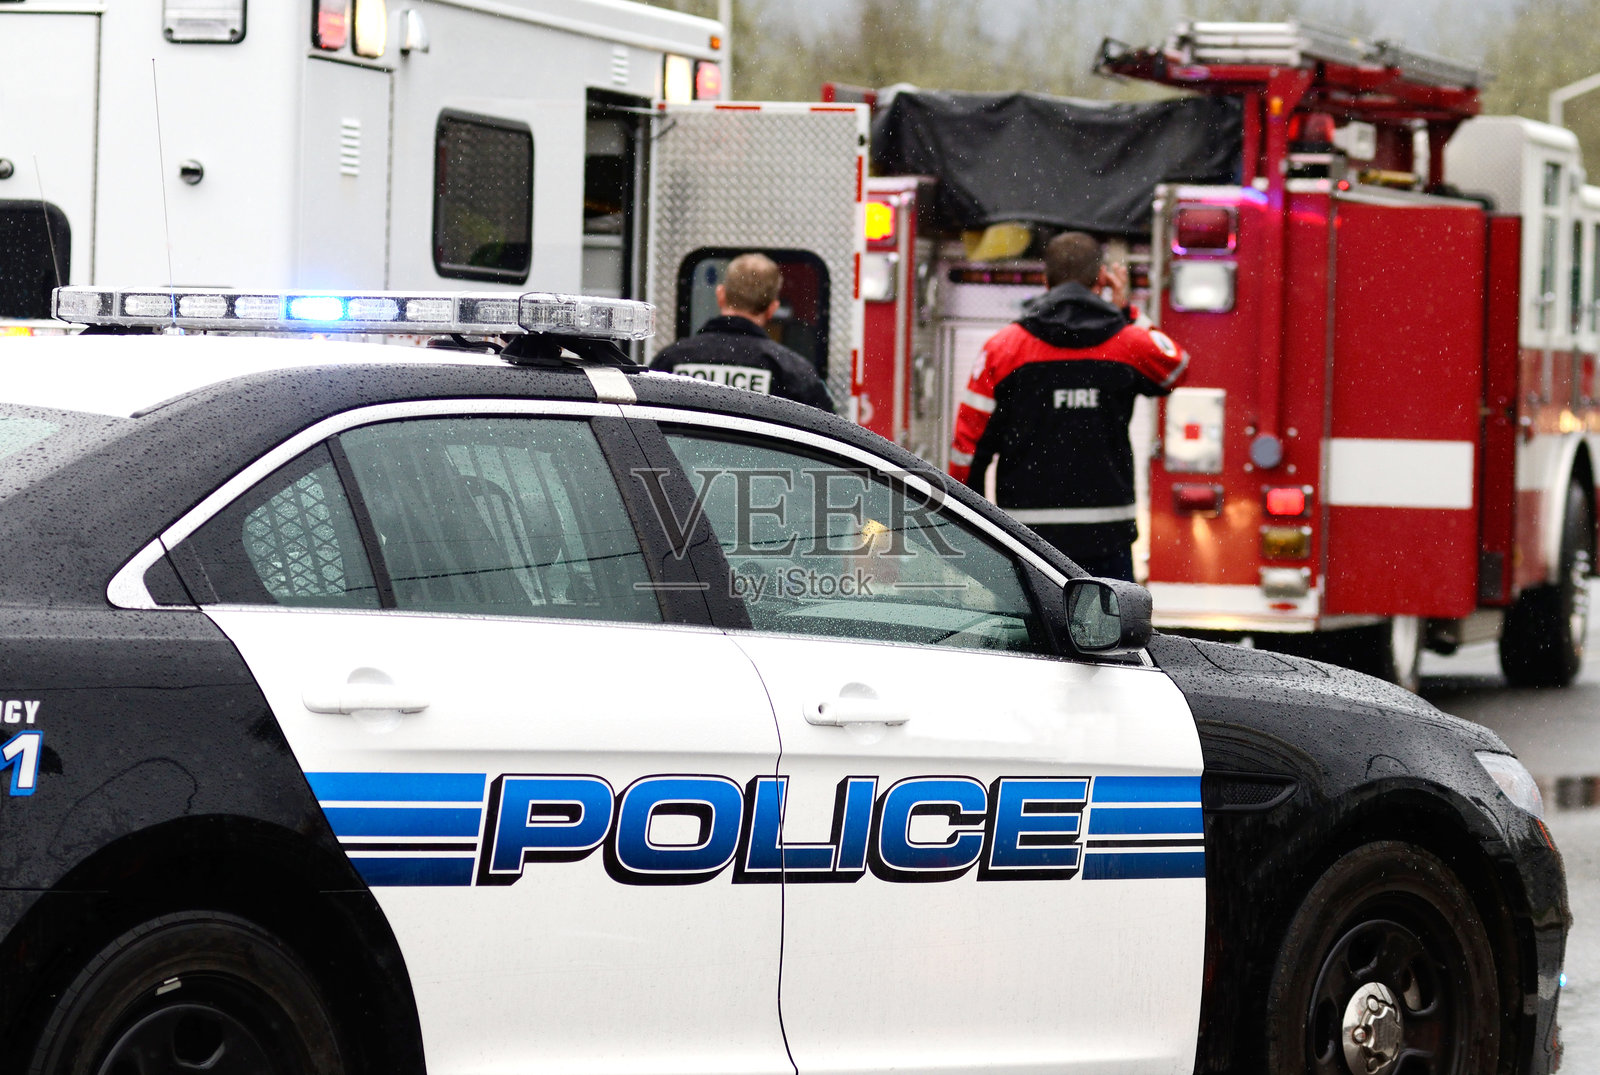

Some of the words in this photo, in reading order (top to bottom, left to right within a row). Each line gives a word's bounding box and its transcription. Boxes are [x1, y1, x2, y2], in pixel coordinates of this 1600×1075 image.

[676, 370, 765, 393] ICE
[1053, 388, 1100, 409] FIRE
[0, 700, 41, 724] CY
[476, 774, 1091, 886] POLICE
